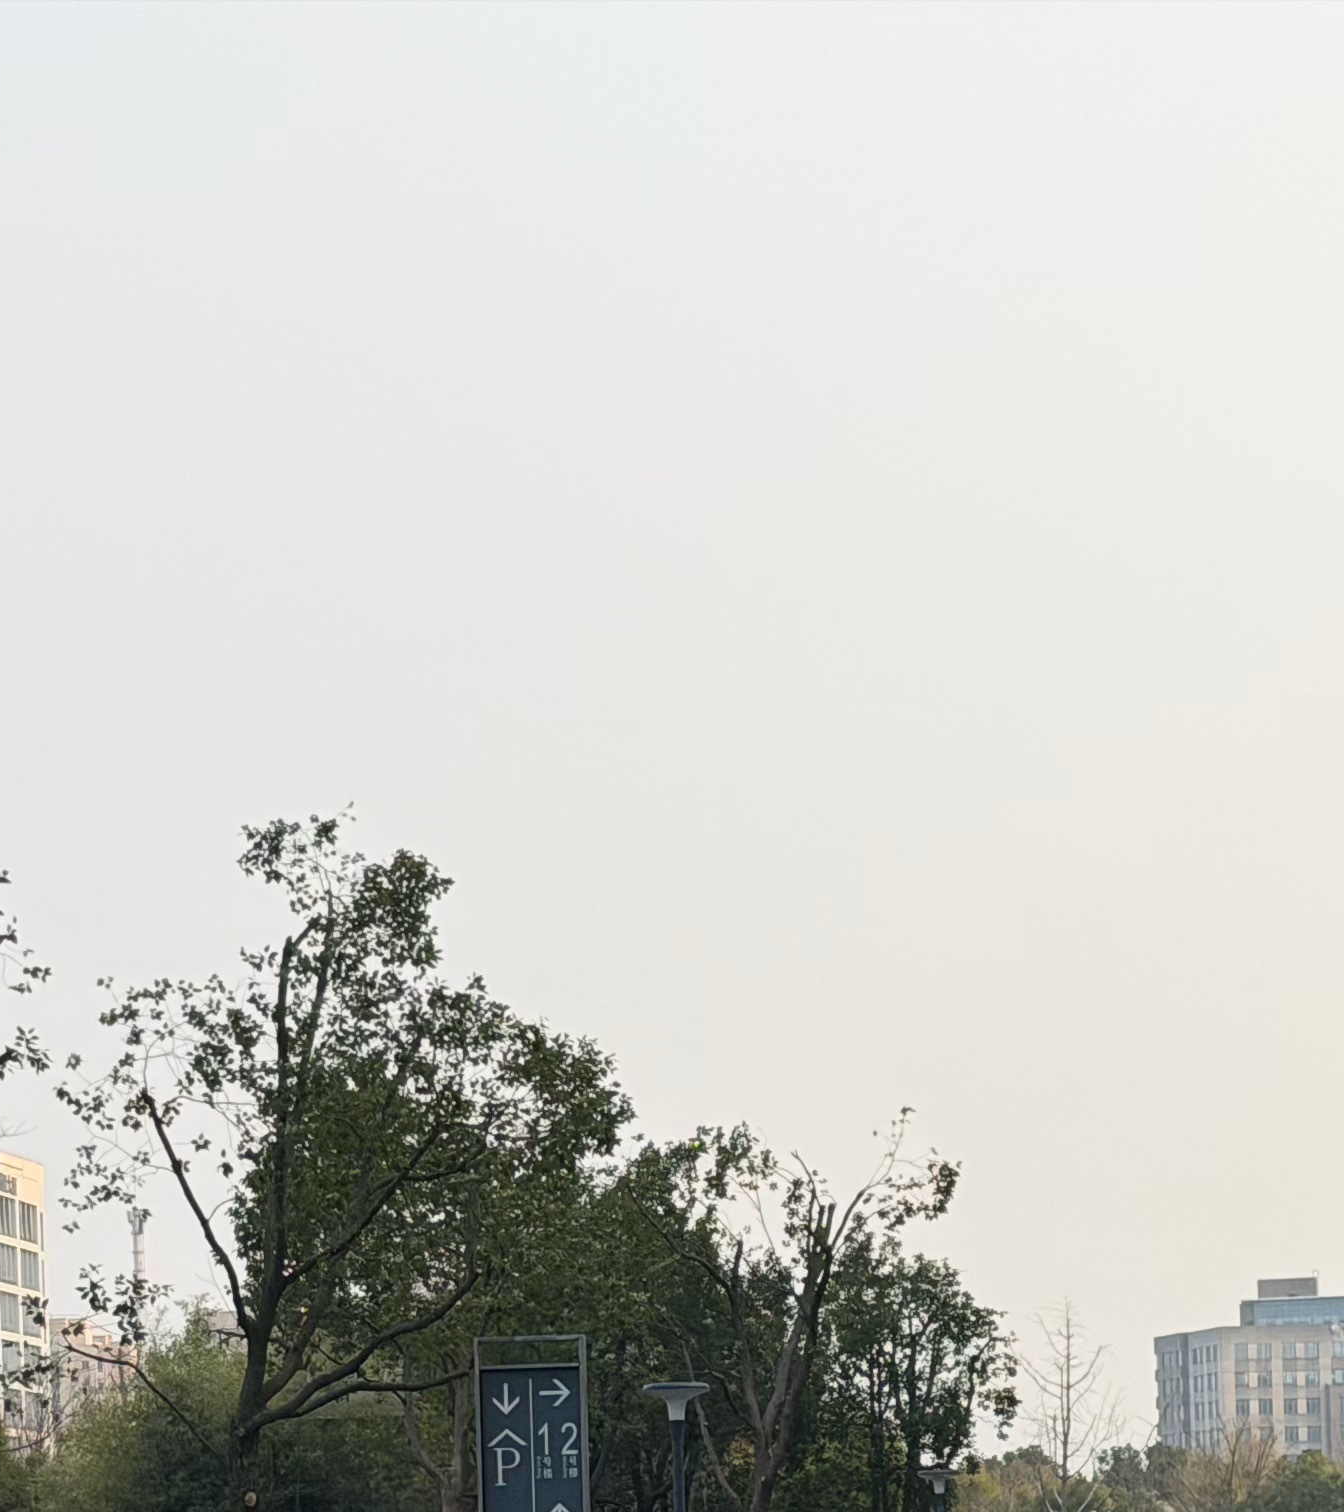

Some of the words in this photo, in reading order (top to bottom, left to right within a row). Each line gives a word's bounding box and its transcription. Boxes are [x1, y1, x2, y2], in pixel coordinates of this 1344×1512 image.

[537, 1422, 549, 1455] 1
[561, 1422, 579, 1455] 2
[493, 1447, 521, 1487] P
